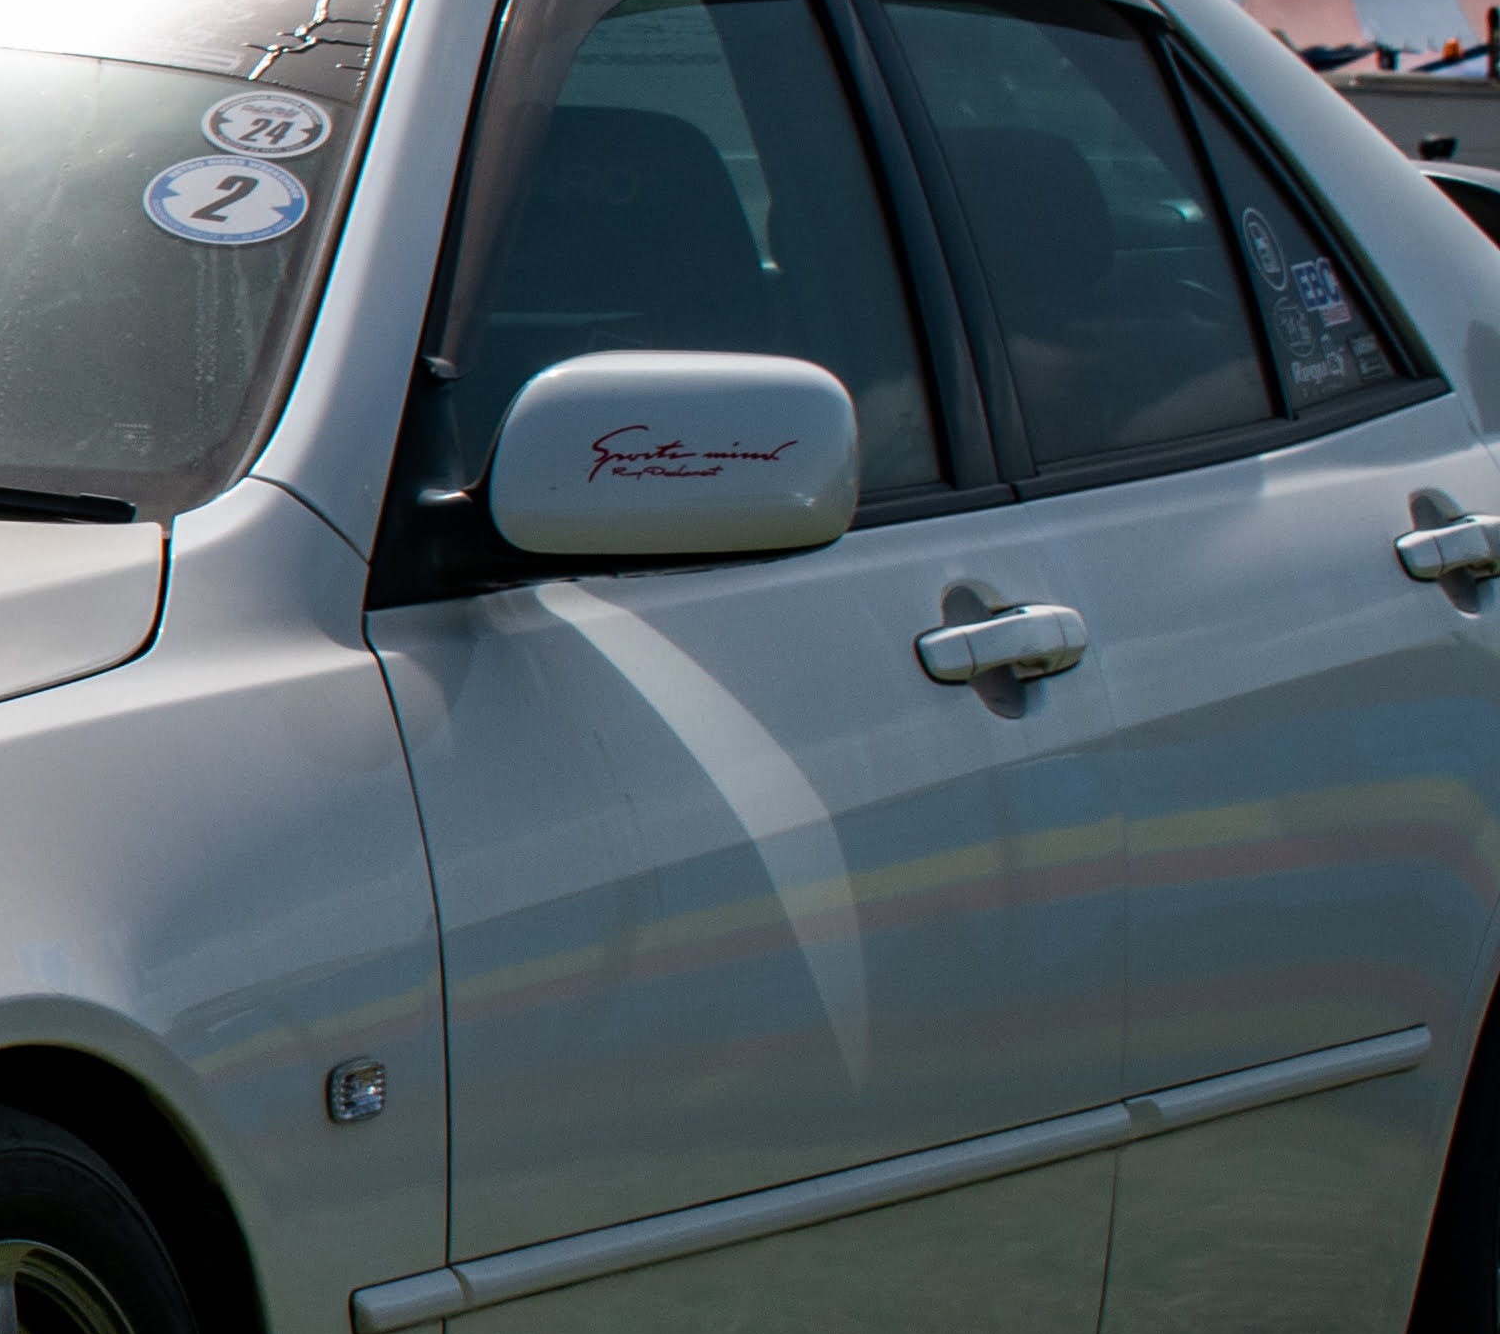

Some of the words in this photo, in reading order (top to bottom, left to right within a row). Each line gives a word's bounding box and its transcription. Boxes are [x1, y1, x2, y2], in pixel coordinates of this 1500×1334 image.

[238, 118, 295, 146] 24
[190, 175, 260, 222] 2
[1292, 257, 1342, 310] EBC
